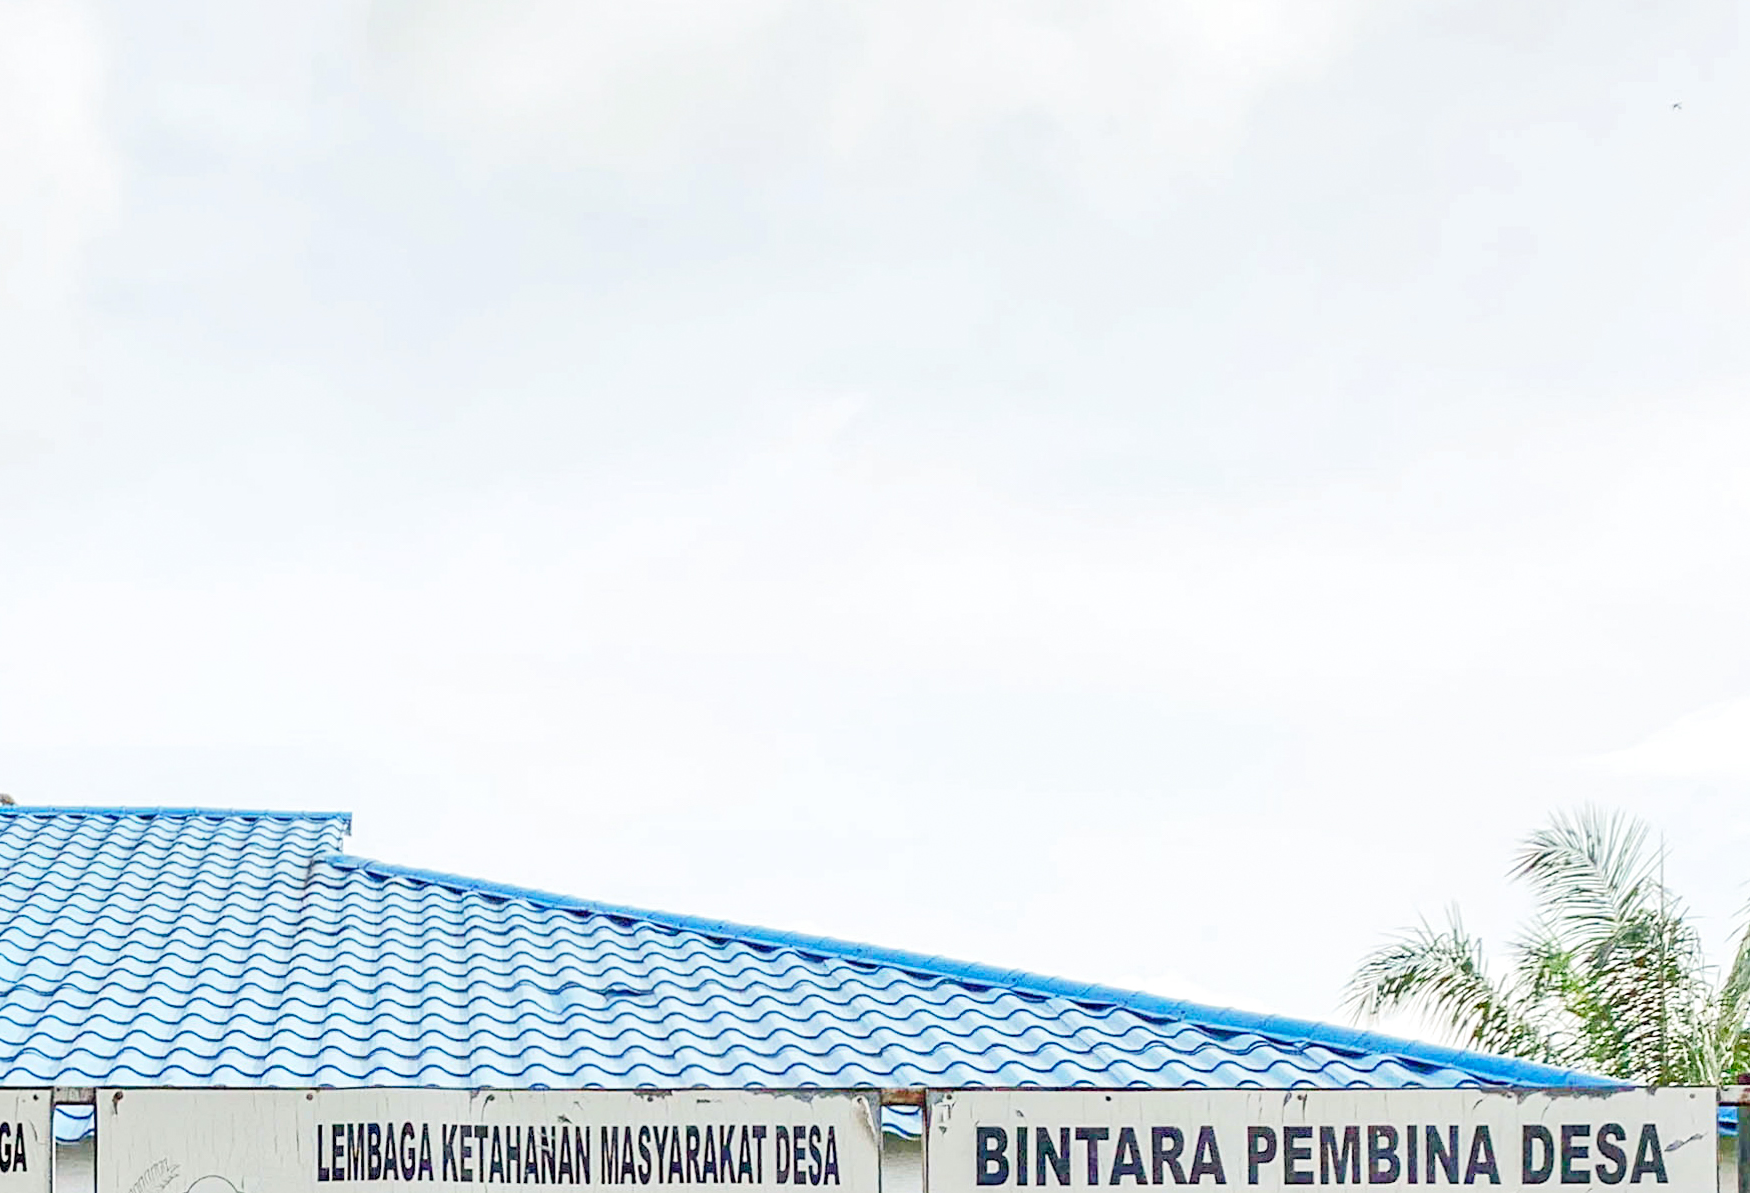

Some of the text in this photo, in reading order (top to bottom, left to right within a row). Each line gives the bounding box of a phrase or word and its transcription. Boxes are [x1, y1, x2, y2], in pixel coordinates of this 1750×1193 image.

[318, 1122, 840, 1185] LEMBAGA KETAHANAN MASYARAKAT DESA
[977, 1124, 1668, 1186] BINTARA PEMBINA DESA
